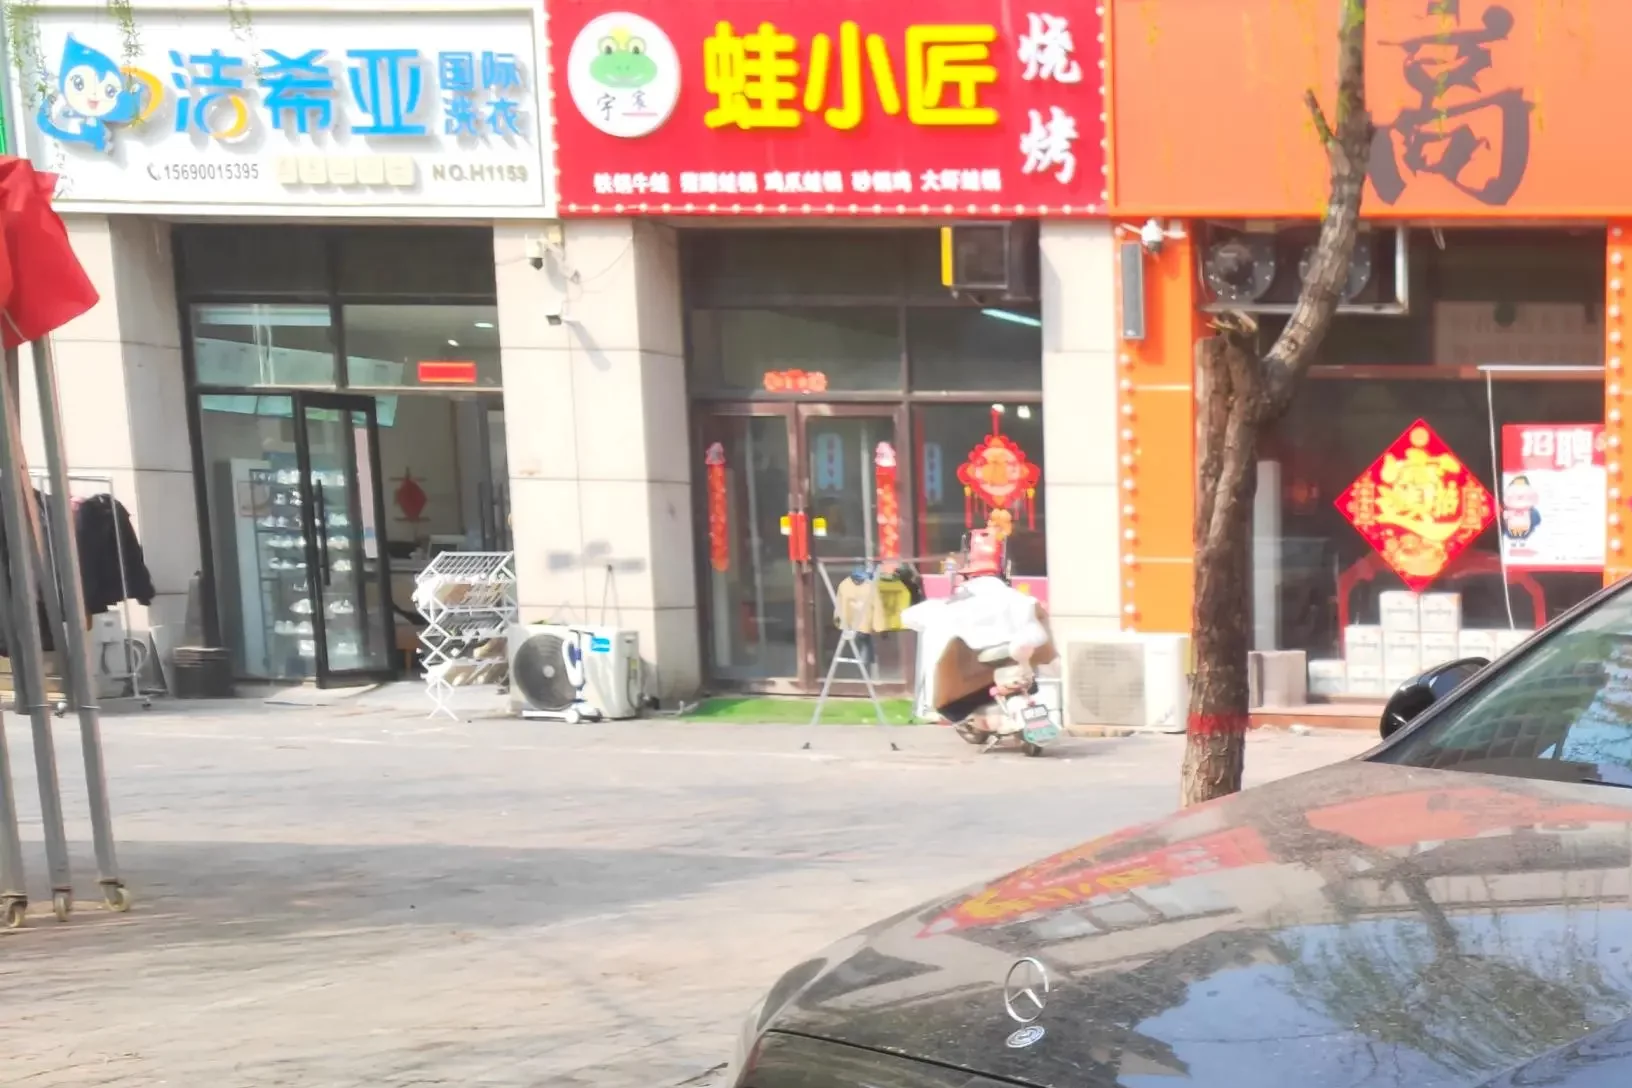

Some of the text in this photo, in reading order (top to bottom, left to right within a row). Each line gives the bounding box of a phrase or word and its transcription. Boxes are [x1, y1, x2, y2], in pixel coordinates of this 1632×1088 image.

[168, 48, 425, 138] 洁希亚
[438, 51, 521, 90] 国际
[704, 20, 1000, 130] 蛙小匠
[1020, 11, 1082, 184] 烧烤
[1368, 0, 1536, 206] 高
[442, 96, 520, 136] 洗衣
[164, 162, 259, 180] 15690015395
[1521, 428, 1593, 468] 招聘
